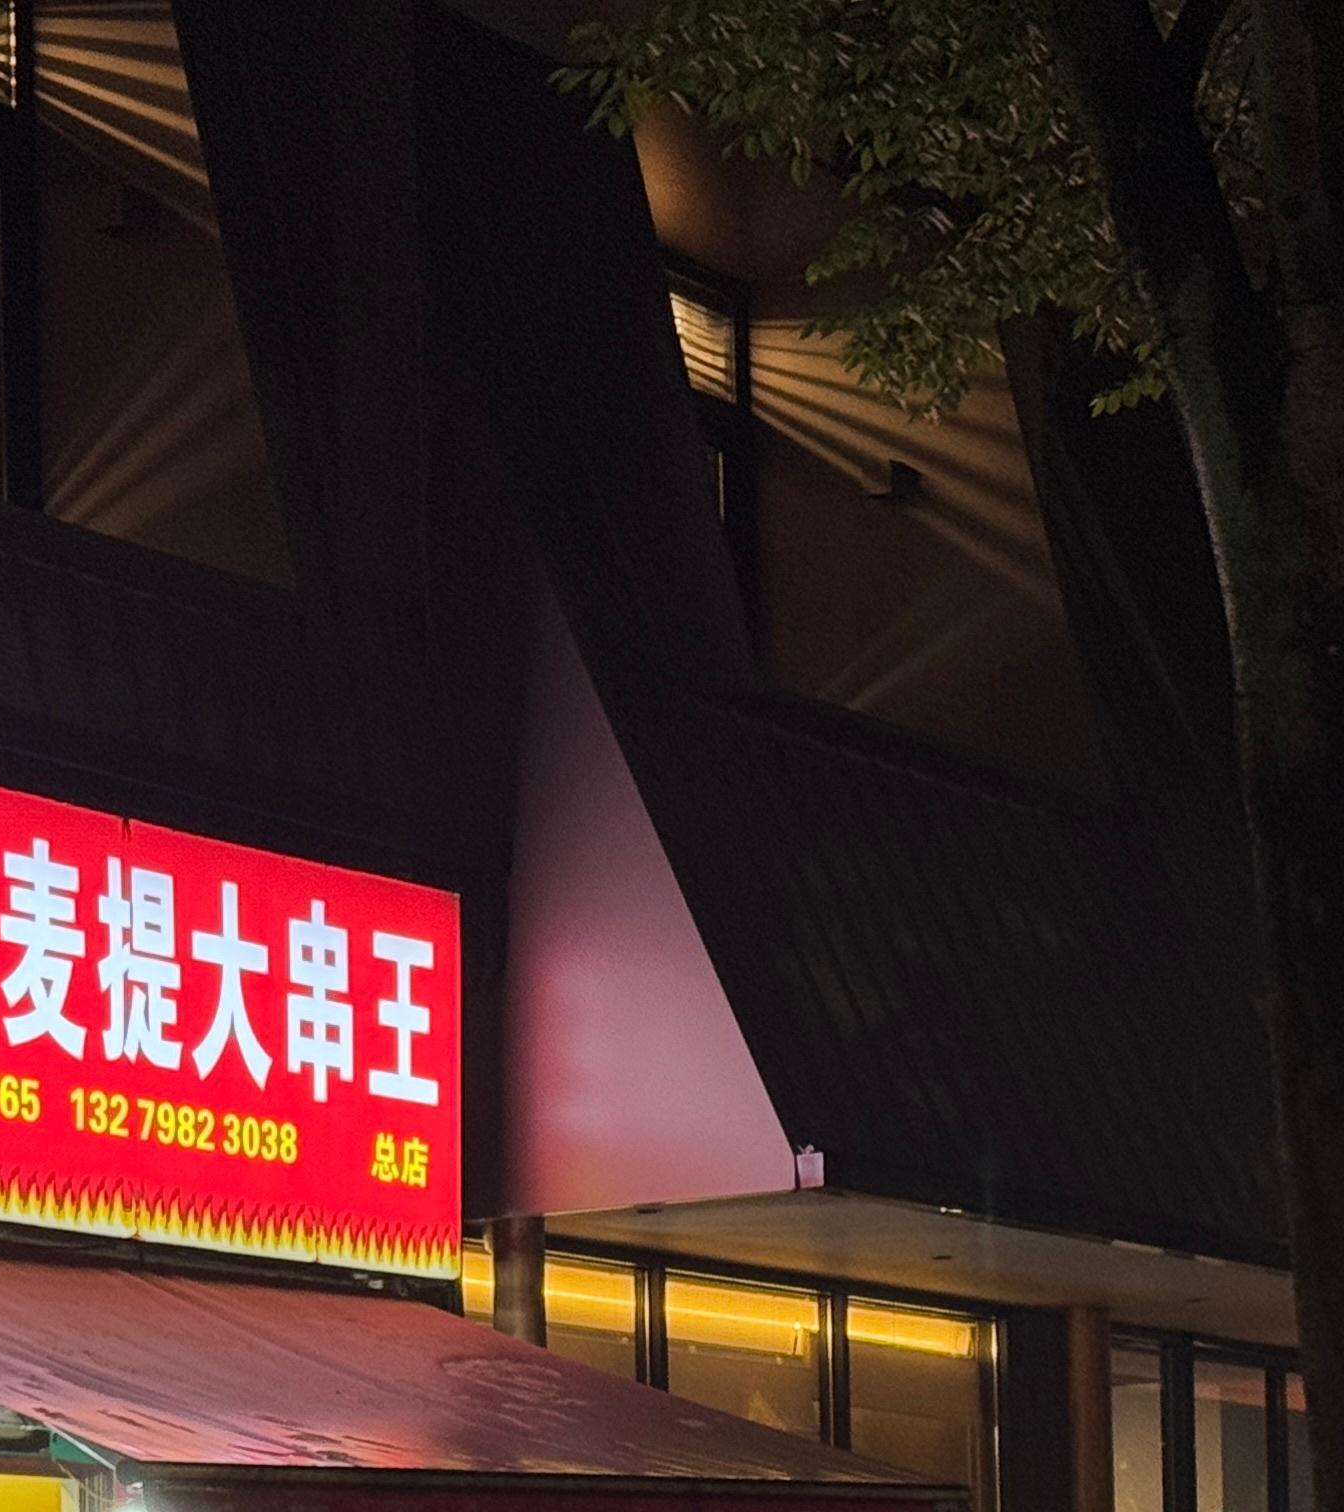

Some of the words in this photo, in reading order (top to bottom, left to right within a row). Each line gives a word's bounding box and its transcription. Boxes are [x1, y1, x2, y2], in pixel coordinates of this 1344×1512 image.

[70, 1087, 128, 1138] 132
[139, 1099, 215, 1151] 7982
[223, 1114, 298, 1165] 3038
[370, 1132, 429, 1187] 总店
